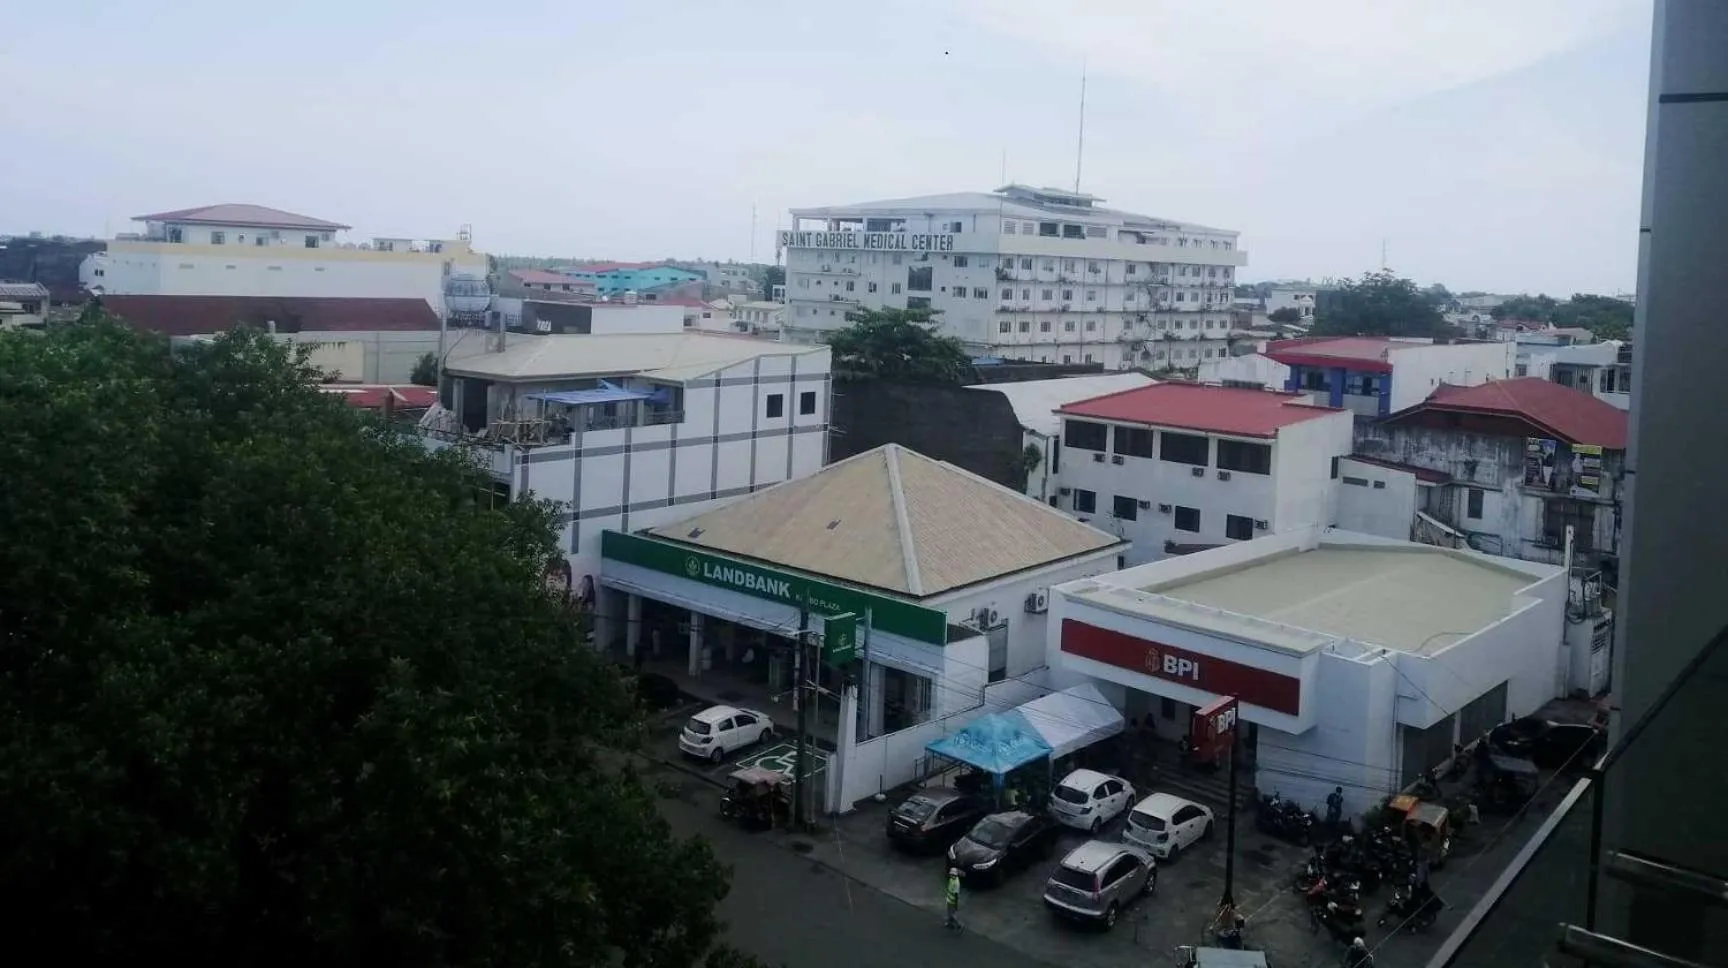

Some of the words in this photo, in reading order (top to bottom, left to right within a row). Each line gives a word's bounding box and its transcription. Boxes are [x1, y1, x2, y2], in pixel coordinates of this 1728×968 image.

[782, 232, 812, 247] SAINT
[817, 232, 860, 248] GABRIEL
[864, 233, 907, 250] MEDICAL
[912, 234, 953, 251] CENTER
[704, 562, 791, 598] LANDBANK
[1164, 655, 1199, 680] BPI
[1217, 707, 1236, 734] BPI
